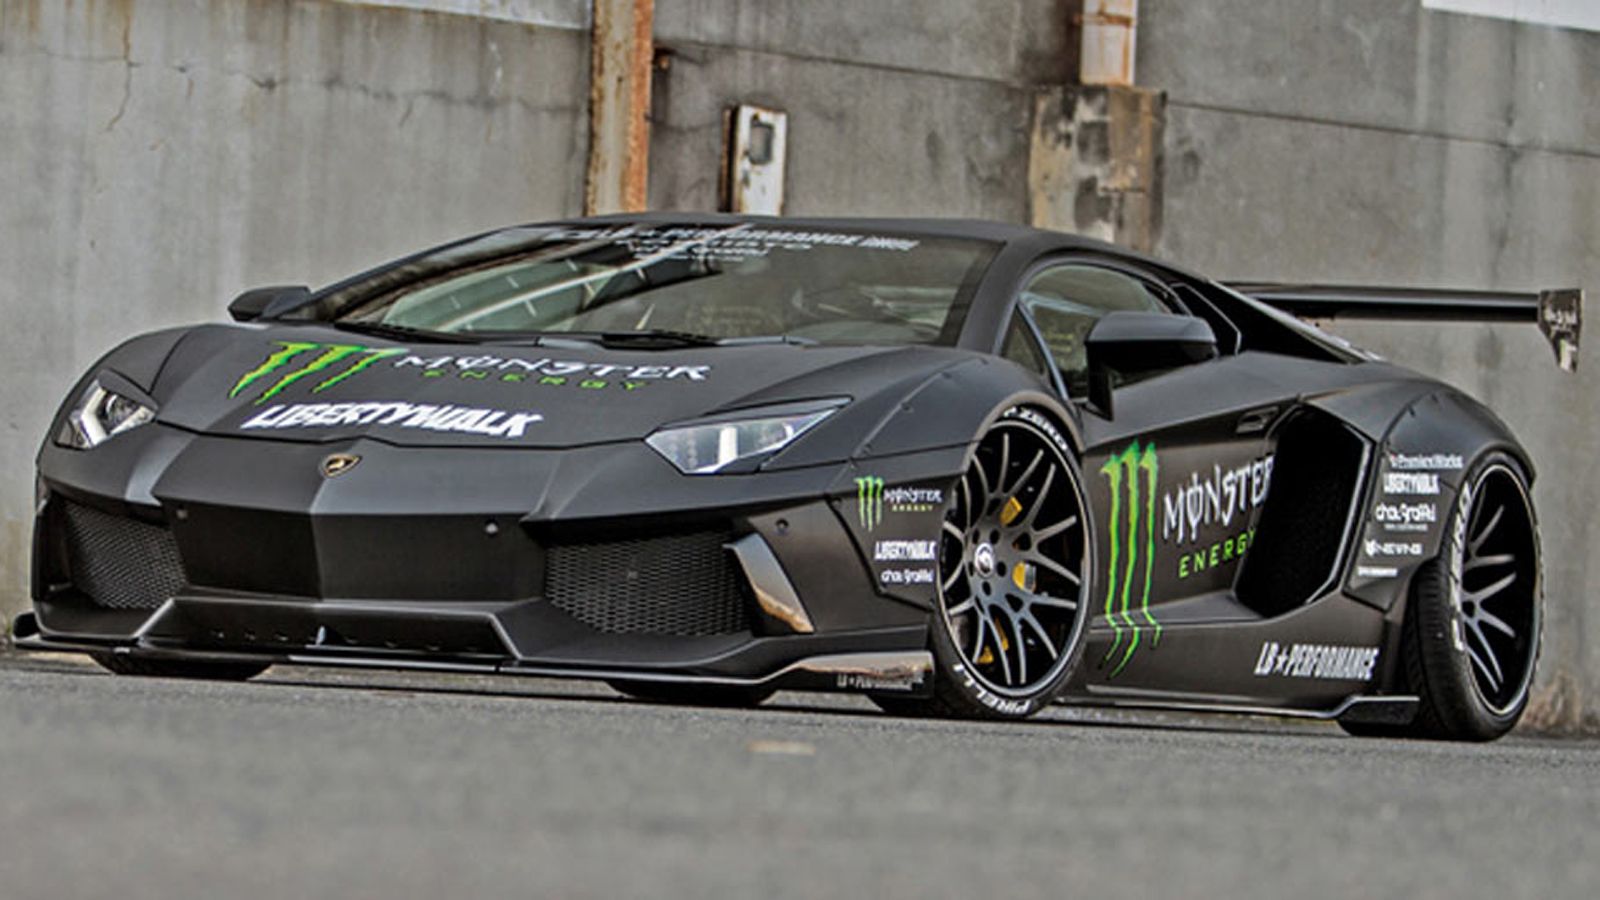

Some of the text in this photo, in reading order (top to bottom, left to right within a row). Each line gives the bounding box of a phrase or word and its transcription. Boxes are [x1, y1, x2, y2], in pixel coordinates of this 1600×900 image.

[394, 355, 710, 380] MONSTER
[422, 369, 646, 389] ENERGY
[884, 487, 942, 504] MONSTER
[952, 663, 1032, 715] PIRELLI
